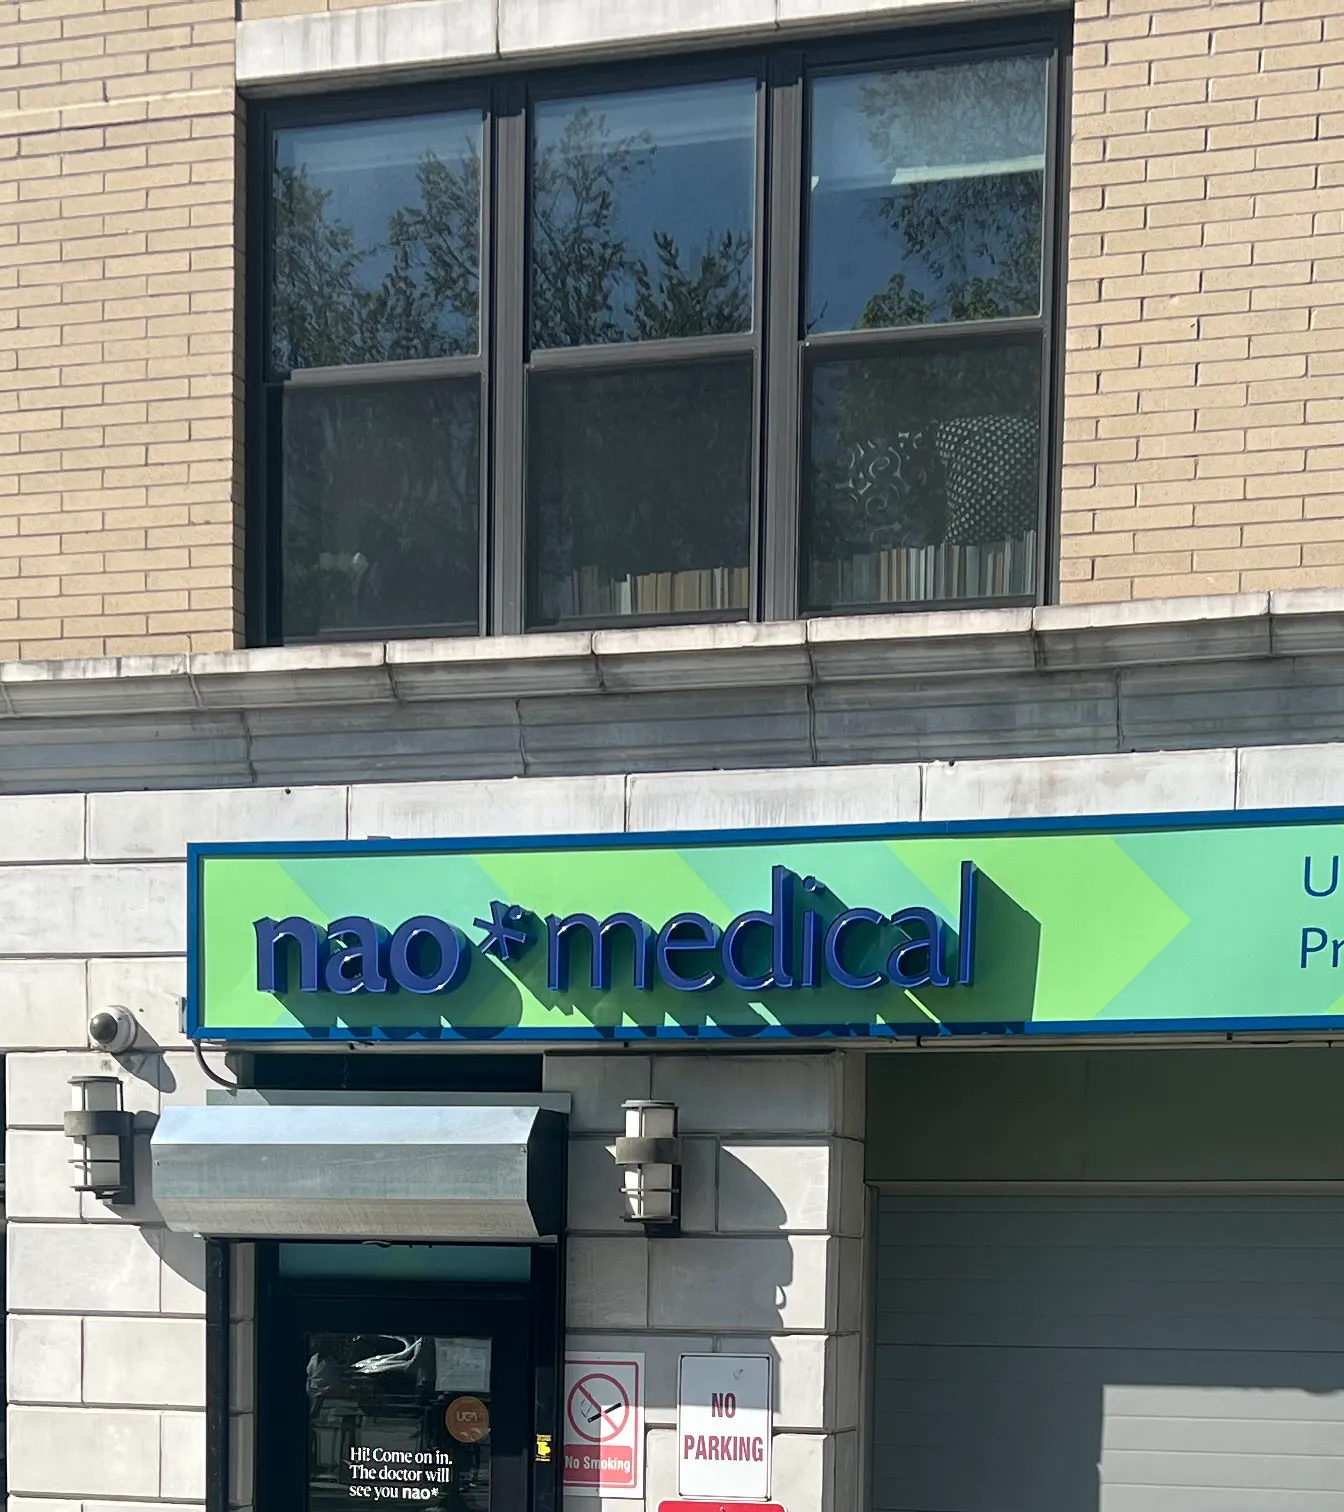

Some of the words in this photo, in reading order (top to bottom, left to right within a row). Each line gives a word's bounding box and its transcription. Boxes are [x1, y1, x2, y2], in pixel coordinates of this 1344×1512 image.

[711, 1392, 737, 1418] NO
[350, 1446, 370, 1462] Hi!
[372, 1447, 413, 1464] Come
[414, 1452, 432, 1464] on
[435, 1449, 453, 1465] in.
[684, 1434, 764, 1462] PARKING
[349, 1464, 376, 1480] The
[378, 1465, 423, 1481] doctor
[425, 1467, 450, 1483] will
[565, 1455, 580, 1469] No
[583, 1456, 631, 1474] Smoking
[349, 1485, 372, 1497] see
[374, 1486, 398, 1501] you
